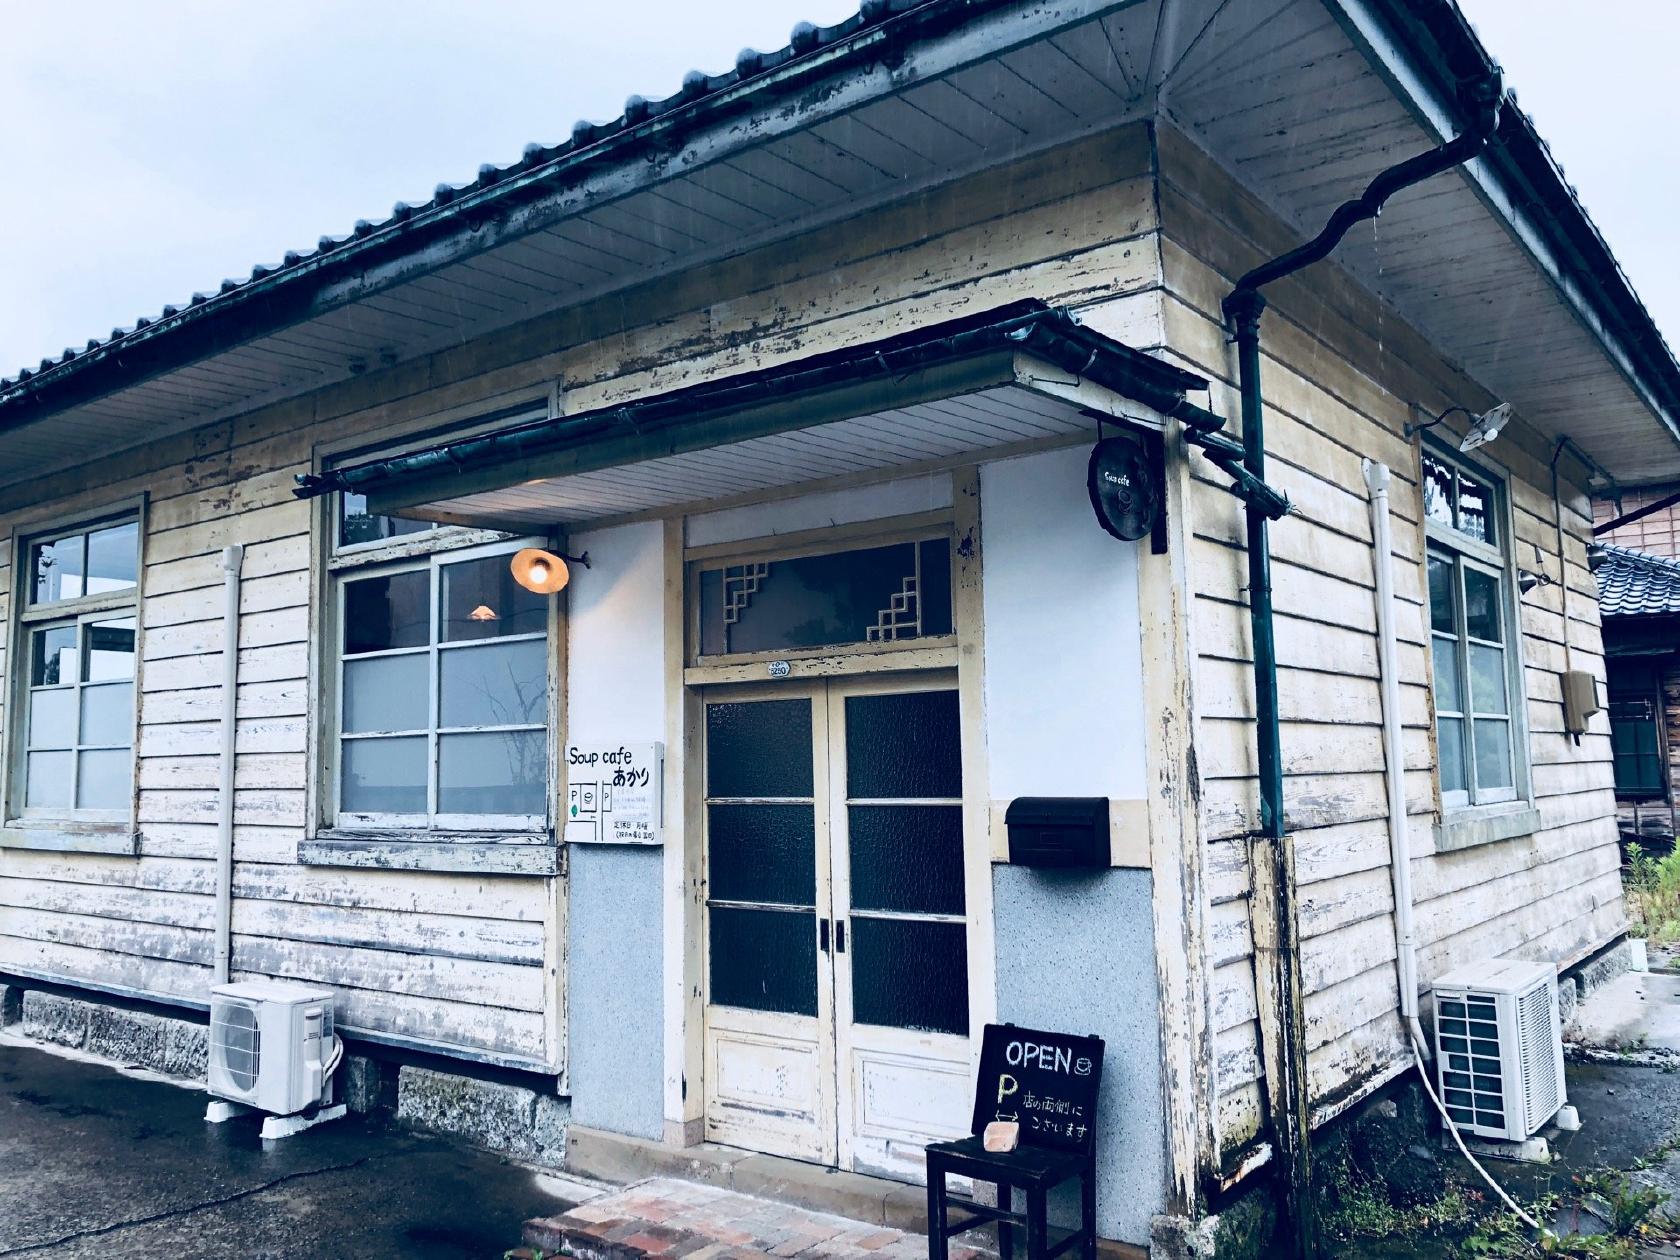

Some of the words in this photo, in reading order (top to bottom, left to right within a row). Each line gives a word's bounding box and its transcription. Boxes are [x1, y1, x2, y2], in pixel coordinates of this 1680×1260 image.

[569, 746, 599, 767] Soup
[602, 746, 632, 765] cafe
[612, 766, 649, 787] あかり
[571, 790, 578, 802] P
[1005, 1041, 1073, 1075] OPEN
[997, 1073, 1019, 1104] P
[1022, 1089, 1083, 1117] 店の両側に
